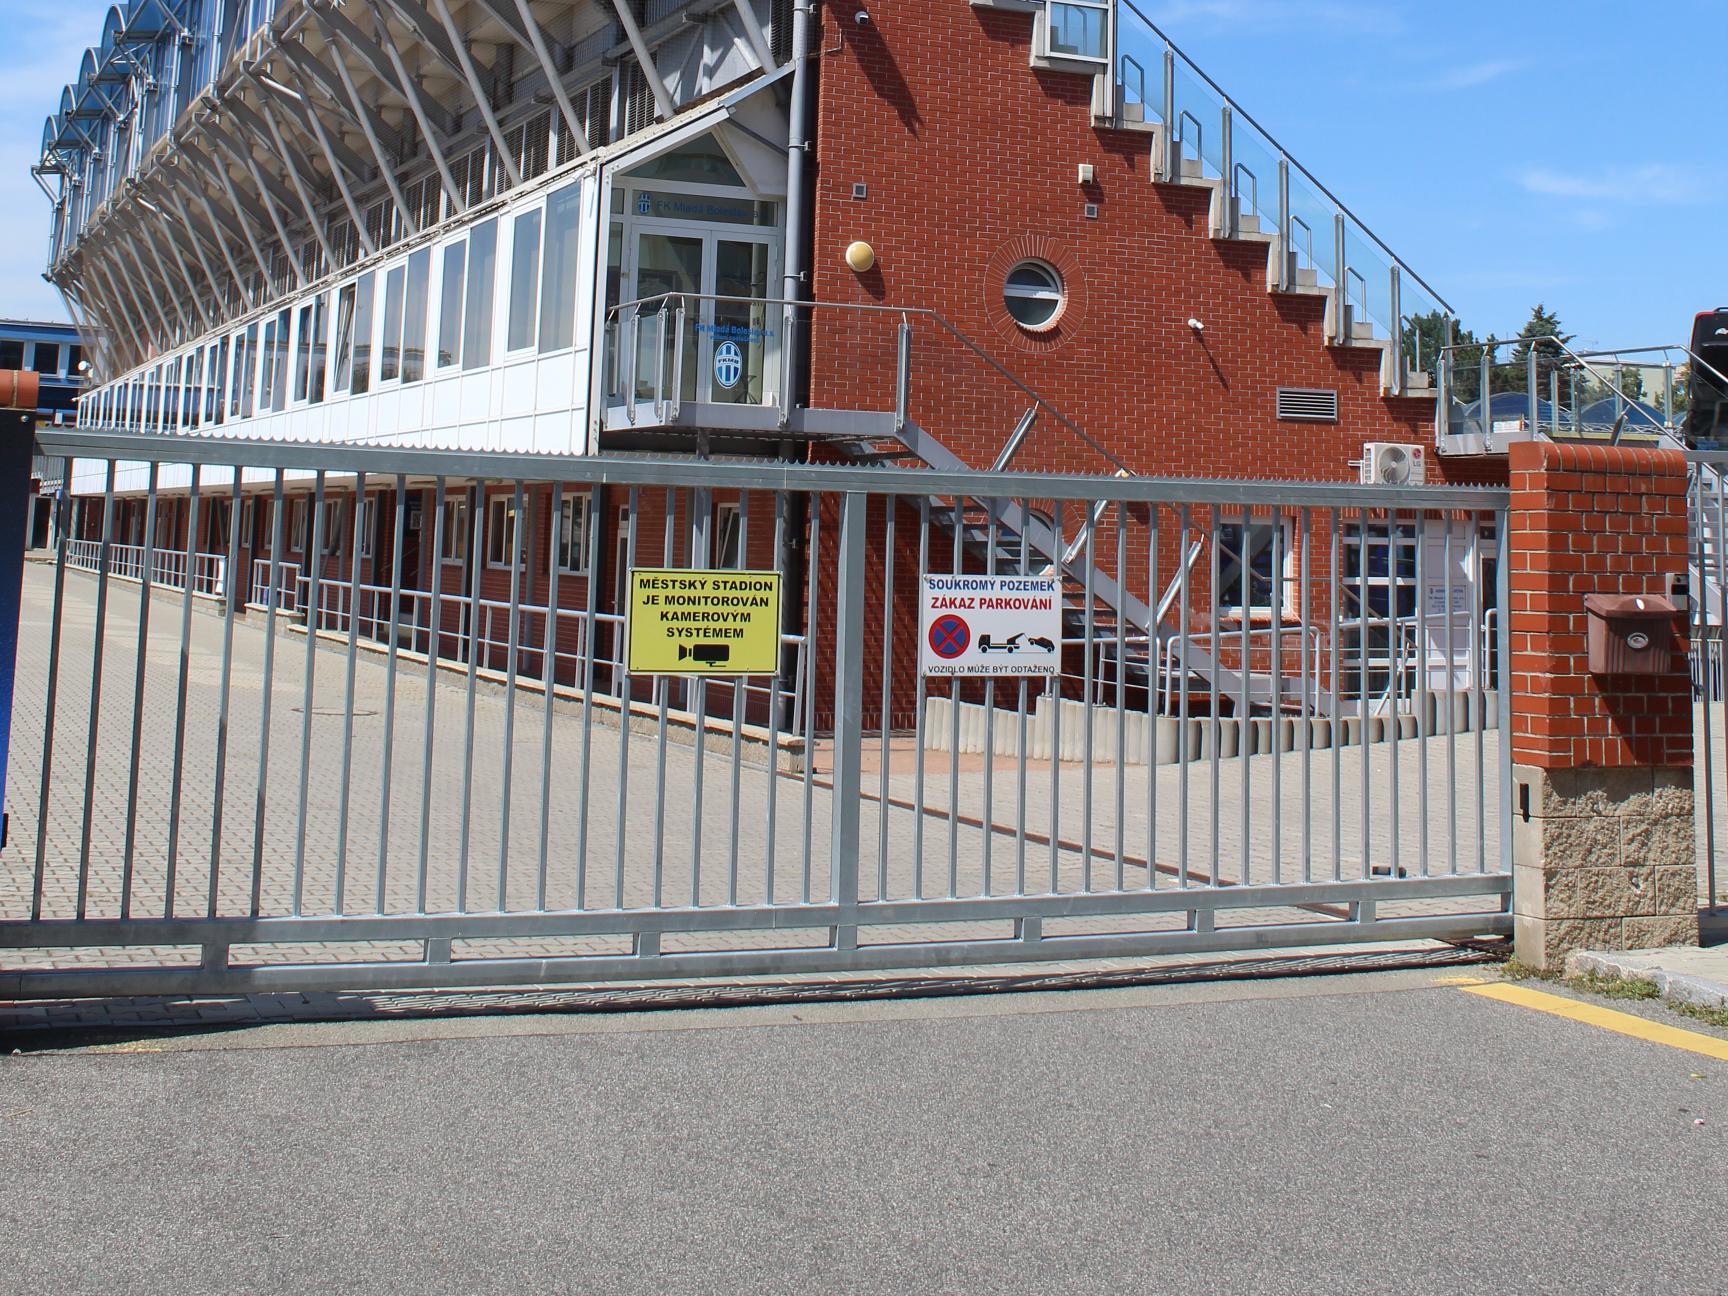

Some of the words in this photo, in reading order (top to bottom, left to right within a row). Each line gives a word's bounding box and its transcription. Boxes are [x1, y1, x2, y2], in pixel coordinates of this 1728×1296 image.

[639, 577, 707, 590] MĚSTSKÝ
[712, 580, 773, 591] STADION
[929, 577, 995, 591] SOUKROMÝ
[1000, 580, 1055, 591] POZEMEK
[642, 595, 659, 605] JE
[665, 595, 769, 607] MONITOROVÁN
[931, 594, 975, 609] ZÁKAZ
[979, 595, 1052, 610] PARKOVÁNÍ
[660, 610, 751, 622] KAMEROVÝM
[666, 625, 744, 638] SYSTÉMEM
[967, 664, 990, 673] MŮŽE
[992, 664, 1008, 673] BÝT
[1010, 664, 1055, 673] ODTAŽENO
